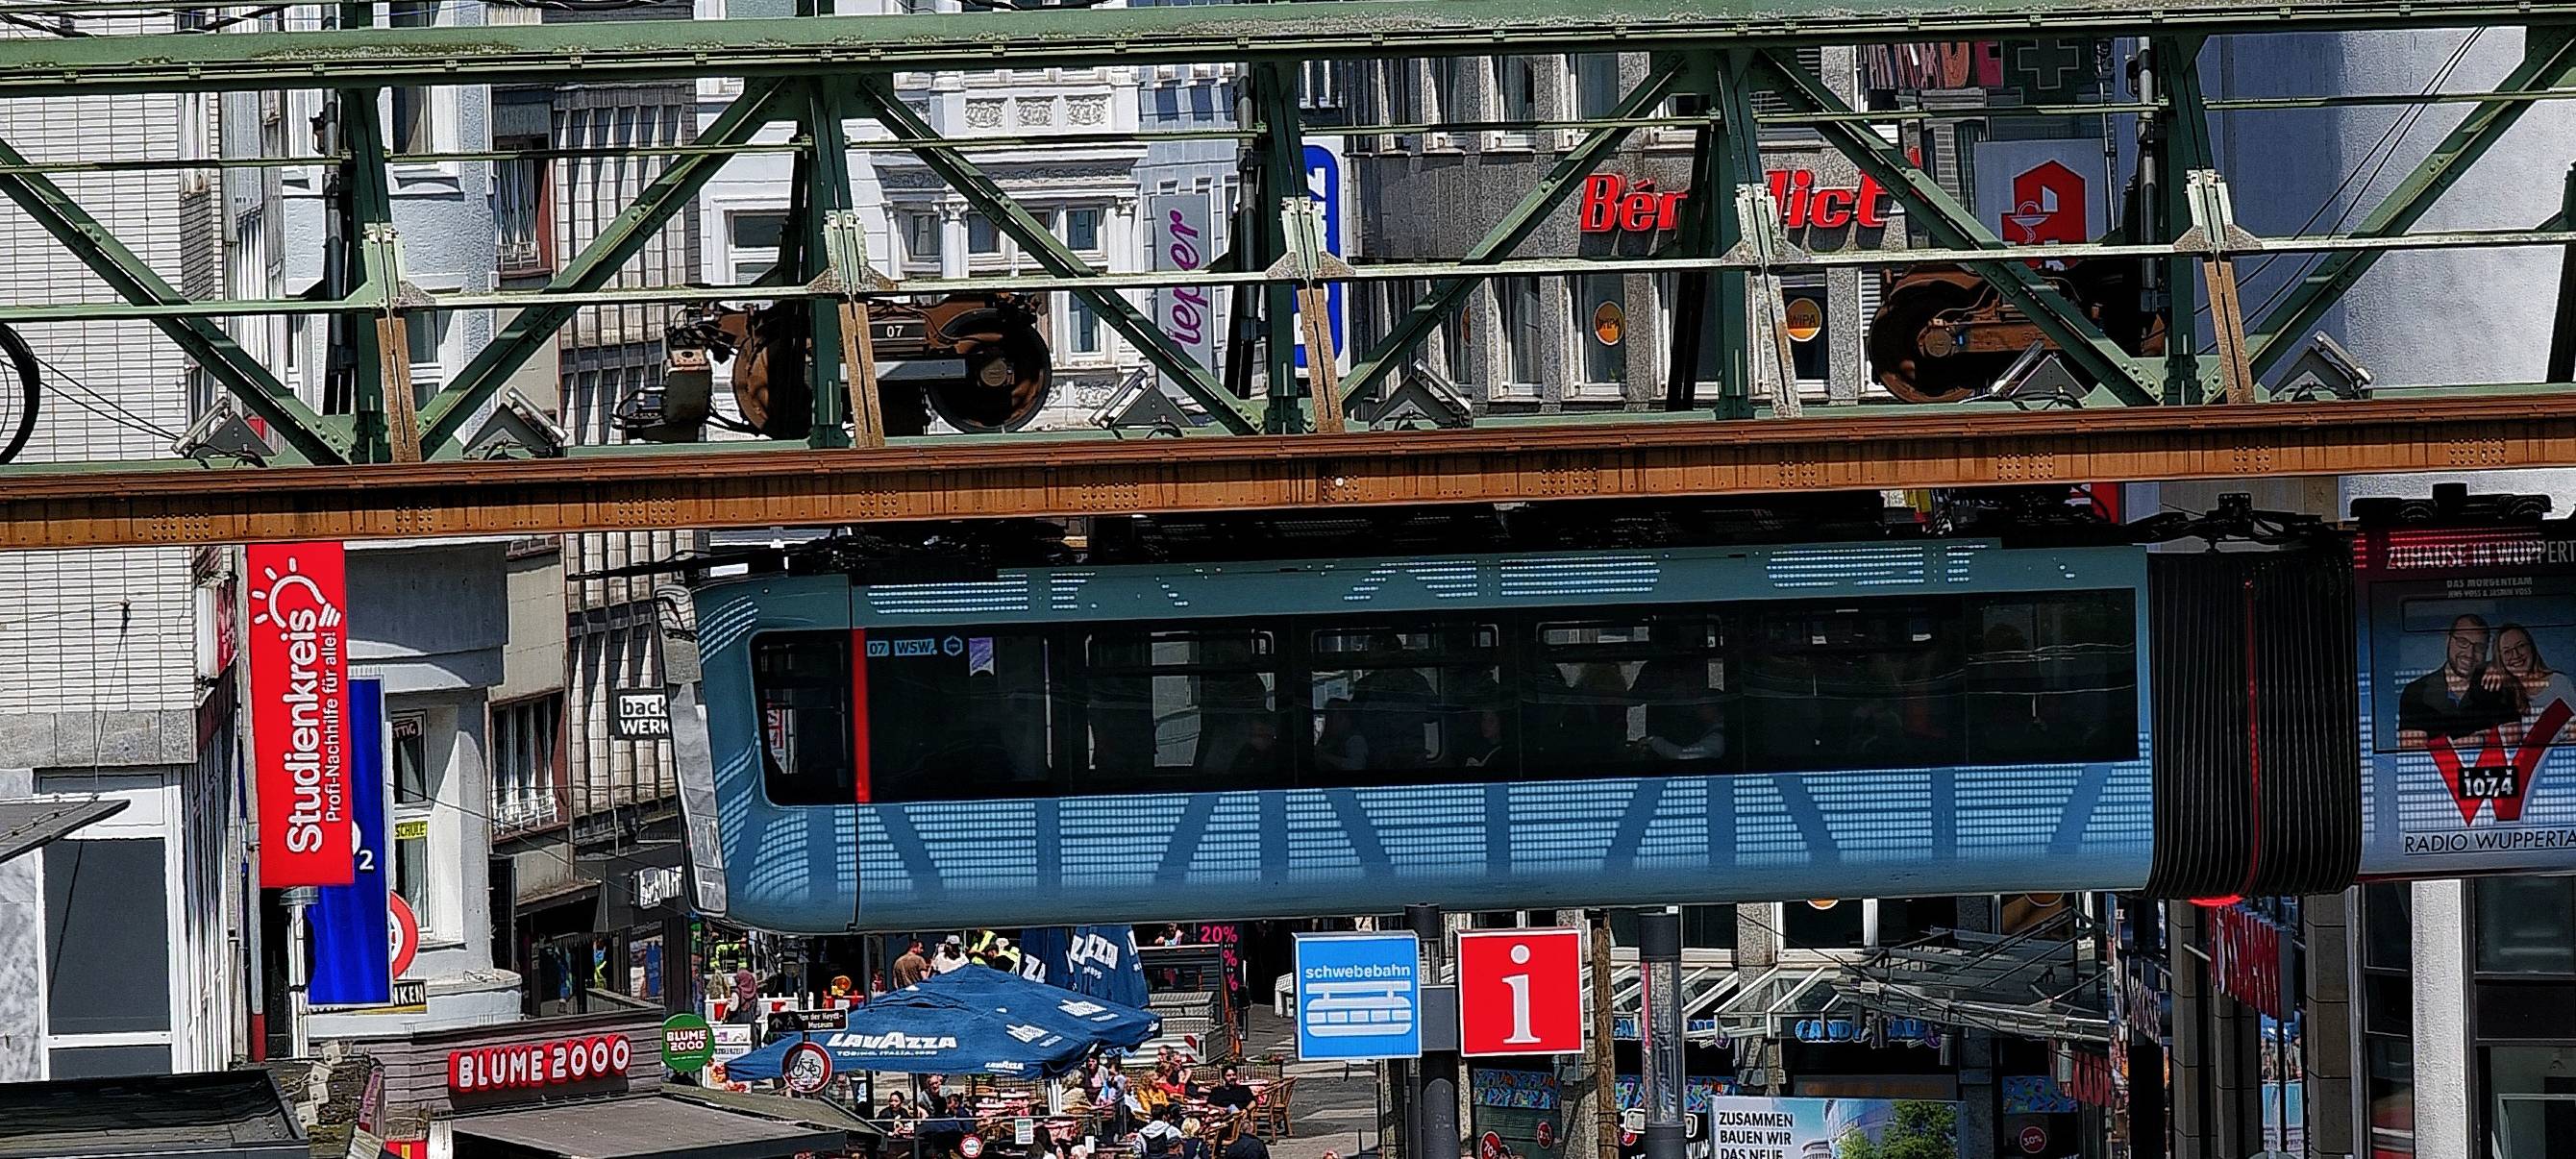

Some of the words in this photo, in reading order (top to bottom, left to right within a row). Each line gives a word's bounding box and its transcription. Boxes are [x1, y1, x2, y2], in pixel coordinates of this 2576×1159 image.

[1790, 313, 1817, 326] WIPA
[886, 325, 904, 337] 07
[2387, 544, 2466, 570] ZUHAUSE
[321, 630, 337, 668] alle!
[869, 642, 885, 655] 07
[321, 671, 338, 694] für
[621, 697, 667, 715] back
[283, 608, 323, 852] Studienkreis
[619, 718, 669, 734] WERK
[322, 699, 342, 823] Profi-Nachhilfe
[2464, 777, 2514, 798] 107,4
[395, 823, 425, 838] SCHULE
[2404, 833, 2468, 853] RADIO
[1201, 925, 1238, 944] 20%
[1305, 963, 1410, 978] schwebebahn
[666, 1029, 707, 1042] BLUME
[827, 1031, 957, 1049] LAVAZZA
[670, 1041, 705, 1051] 2000
[458, 1049, 544, 1088] BLUME
[551, 1039, 630, 1078] 2000
[1719, 1111, 1794, 1128] ZUSAMMEN
[1720, 1130, 1763, 1146] BAUEN
[1766, 1131, 1792, 1146] WIR
[1721, 1148, 1745, 1159] DAS
